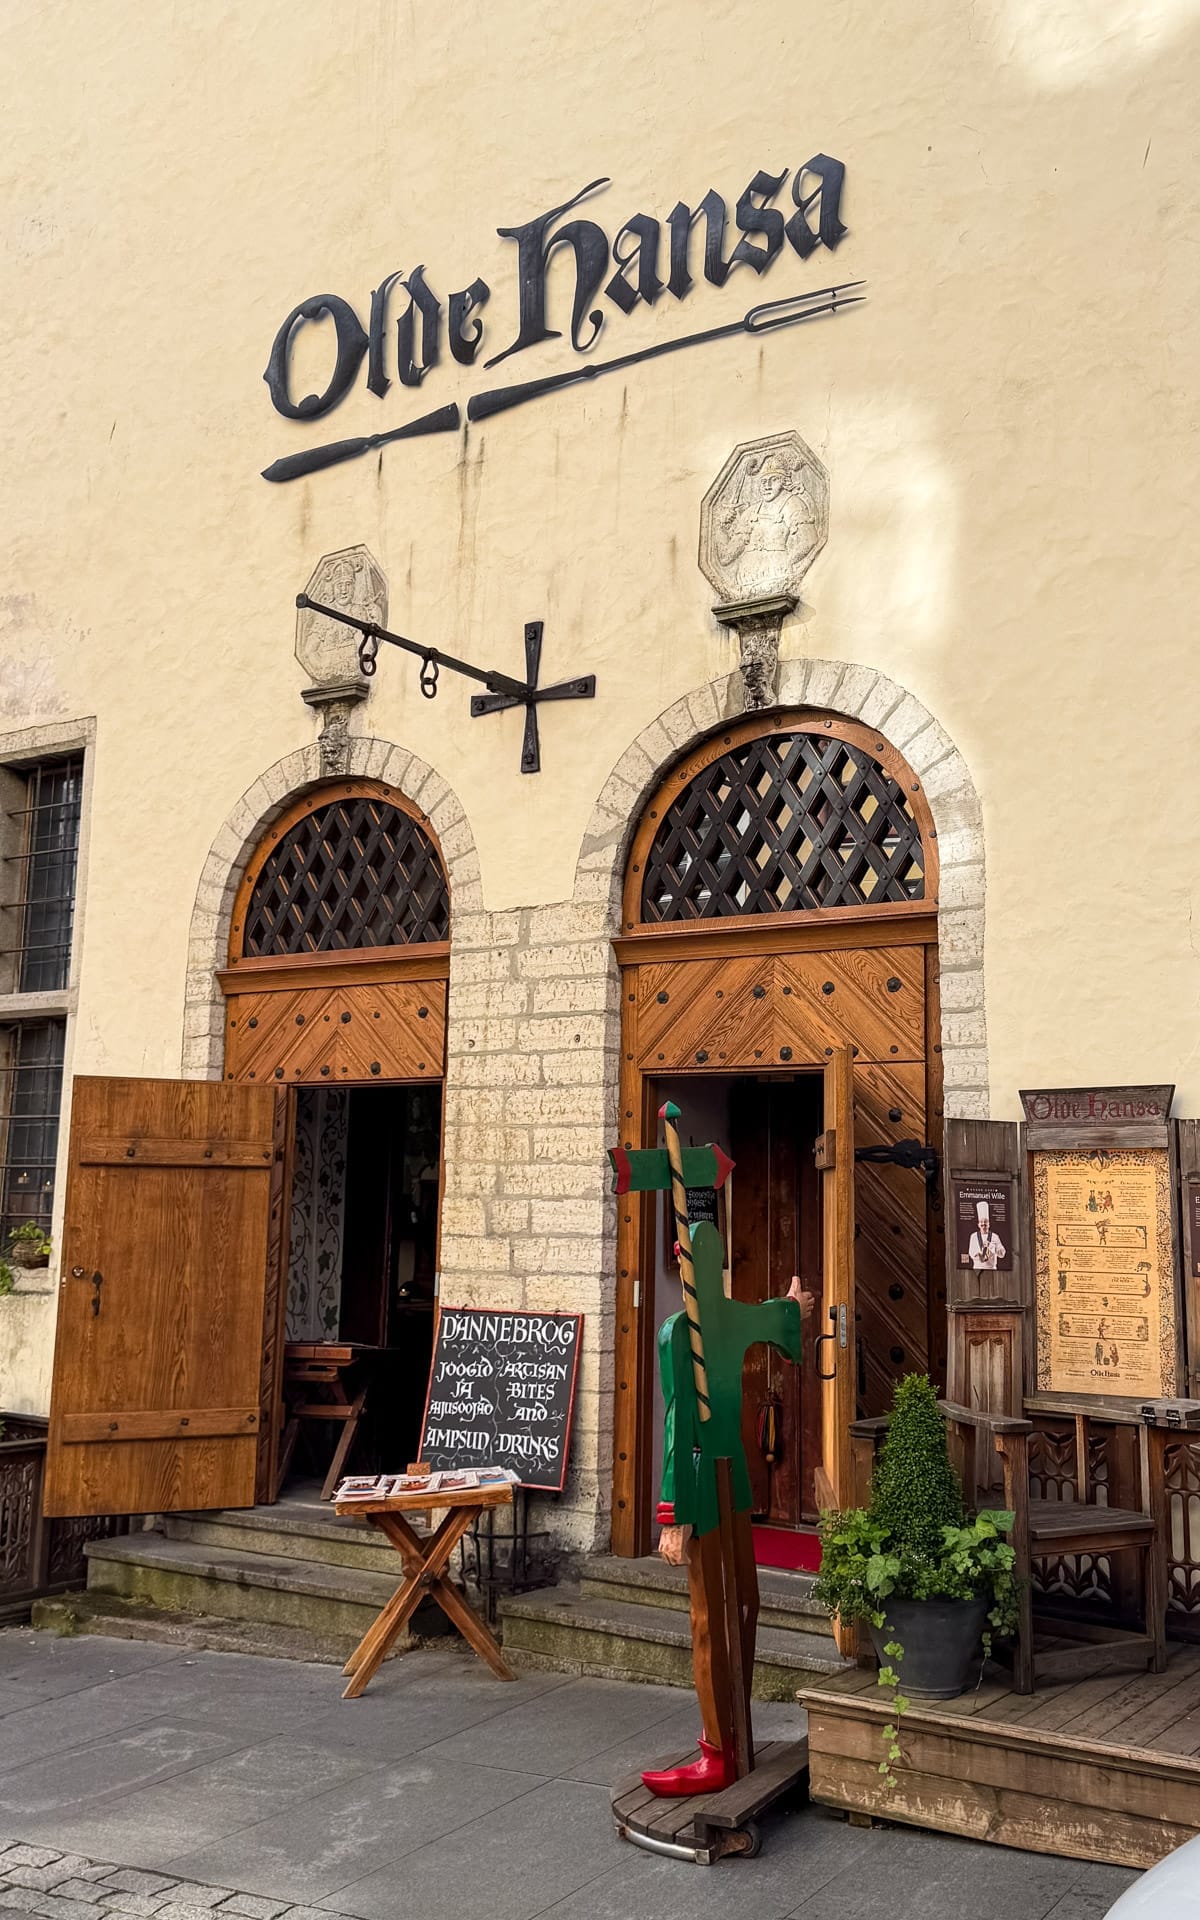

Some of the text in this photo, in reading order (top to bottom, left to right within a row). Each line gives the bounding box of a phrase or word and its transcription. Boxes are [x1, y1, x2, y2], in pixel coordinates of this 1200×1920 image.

[262, 153, 848, 420] Olde Hansa
[1028, 1092, 1162, 1121] Olde Hansa
[959, 1191, 990, 1200] Emmanuel
[441, 1314, 576, 1352] DANNEBROG
[435, 1355, 493, 1382] JOOGID
[499, 1358, 568, 1381] ARTISAN
[450, 1378, 475, 1399] JA
[505, 1381, 557, 1402] BITES
[423, 1426, 490, 1450] AMPSUD
[495, 1433, 561, 1462] DRINKS
